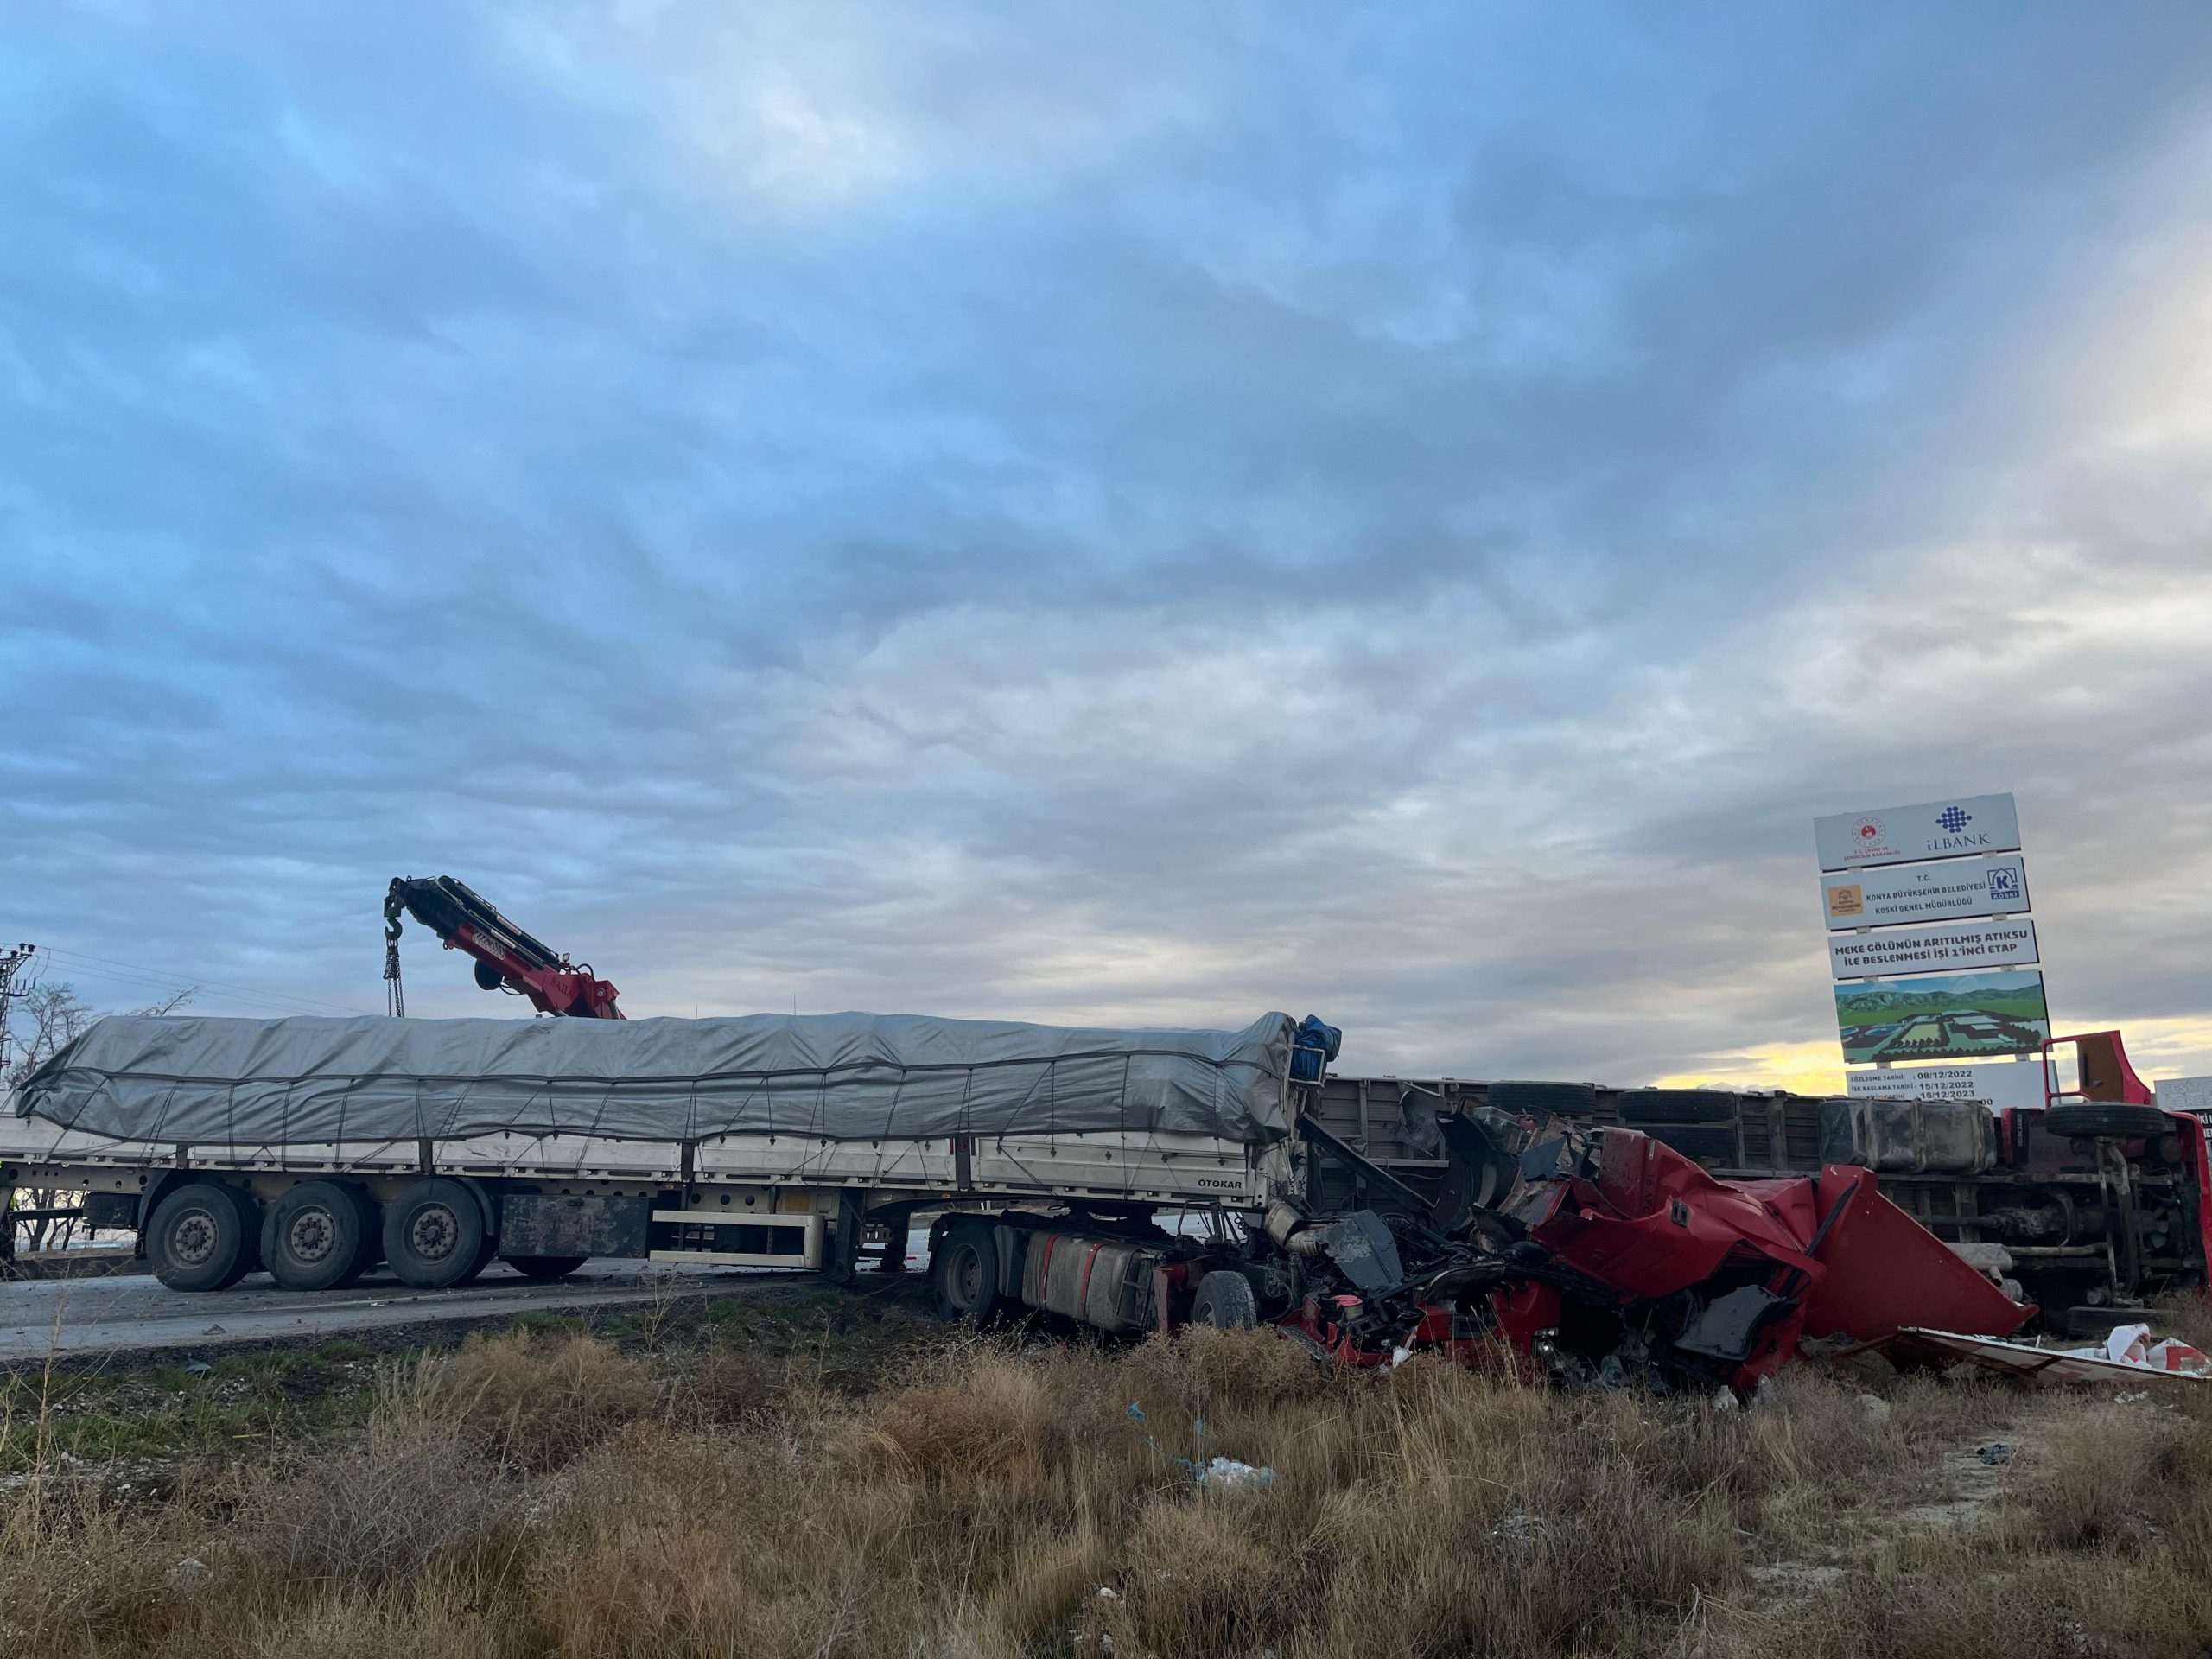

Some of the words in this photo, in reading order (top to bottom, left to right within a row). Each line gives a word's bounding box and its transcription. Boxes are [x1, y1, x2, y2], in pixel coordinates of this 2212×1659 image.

[1996, 875, 2009, 889] K
[1866, 892, 1891, 901] KONYA
[1893, 887, 1941, 899] BÜYÜKŞEHİR
[1942, 881, 1986, 893] BELEDİYESİ
[1875, 904, 1897, 914] KOSKİ
[1900, 903, 1923, 912] GENEL
[1925, 896, 1973, 910] MÜDÜRLÜĞÜ
[1834, 945, 1865, 955] MEKE
[1867, 938, 1921, 952] GÖLÜNÜN
[1923, 934, 1981, 947] ARITILMIŞ
[1985, 930, 2028, 942] ATIKSU
[1844, 956, 1859, 966] İLE
[1863, 949, 1931, 964] BESLENMESİ
[1934, 947, 1948, 960] İŞİ
[1987, 943, 2018, 954] ETAP
[1916, 1071, 1973, 1079] 08/12/2022
[1919, 1081, 1974, 1090] 15/12/2022
[1920, 1090, 1975, 1099] 15/12/2023
[1198, 1179, 1242, 1189] OTOKAR
